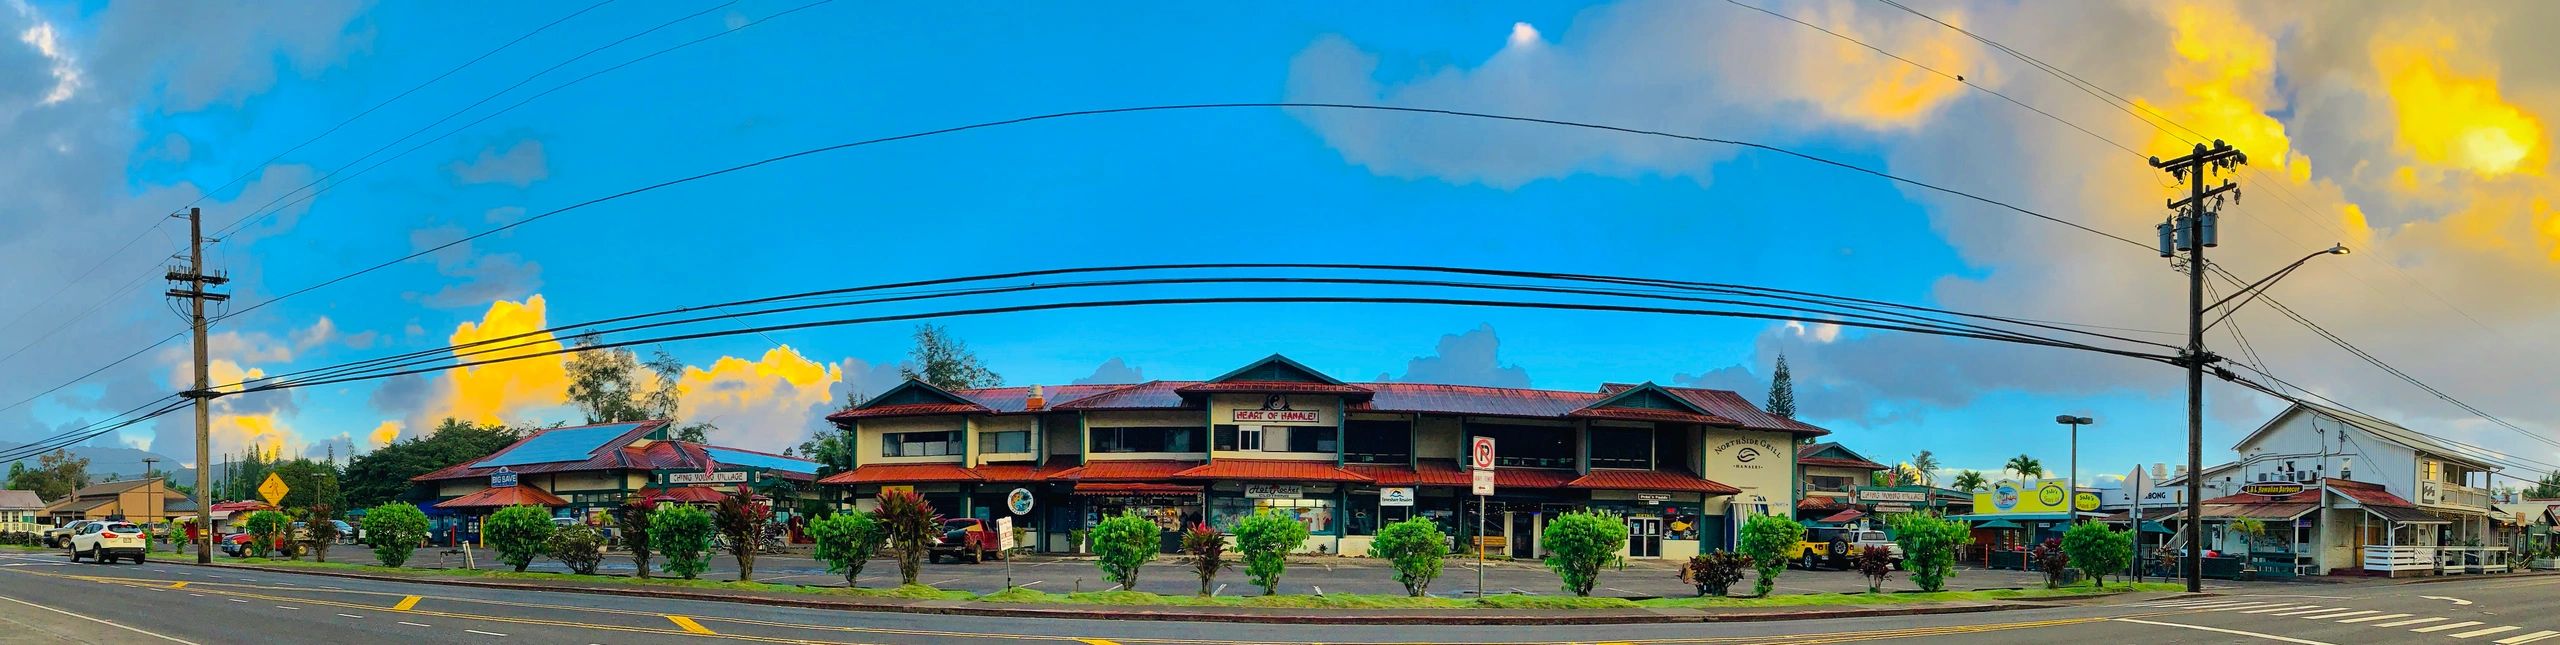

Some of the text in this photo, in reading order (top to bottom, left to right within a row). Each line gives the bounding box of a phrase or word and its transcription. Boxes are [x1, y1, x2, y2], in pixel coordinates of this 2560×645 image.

[1236, 411, 1264, 420] HEART
[1267, 412, 1278, 420] OF
[1760, 440, 1783, 458] GRILL
[502, 475, 516, 483] SAVE
[717, 472, 743, 481] VILLAGE
